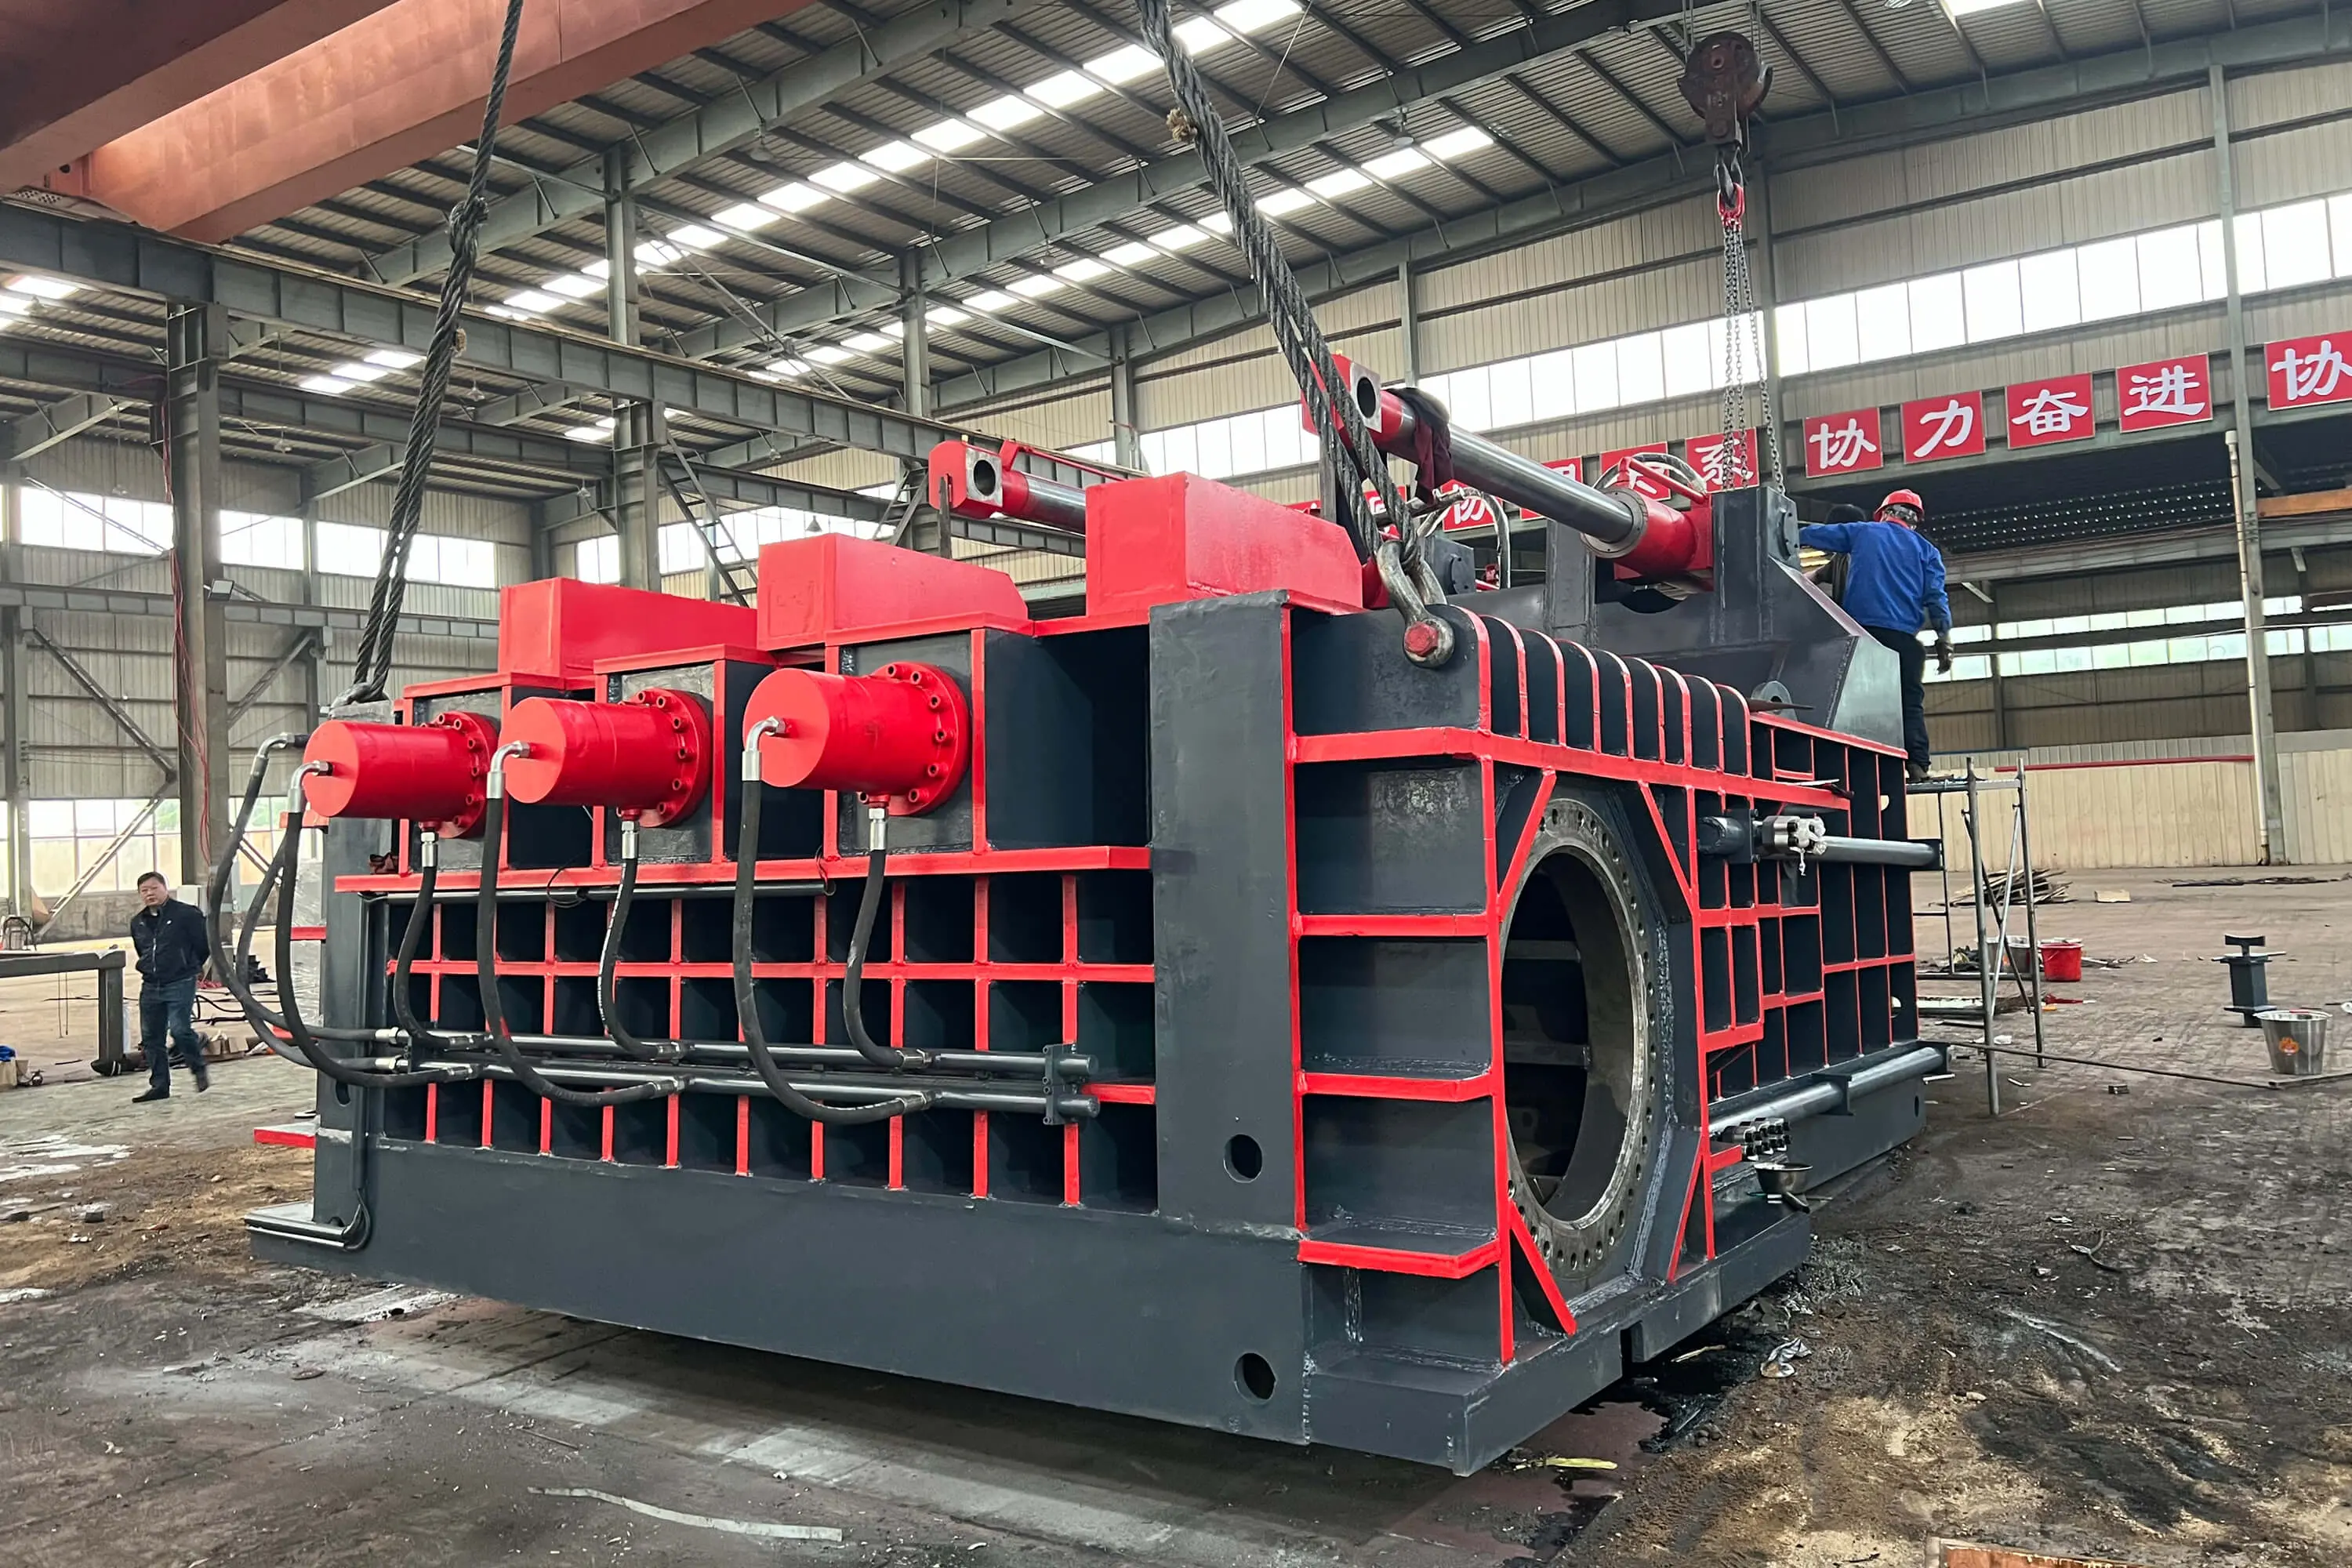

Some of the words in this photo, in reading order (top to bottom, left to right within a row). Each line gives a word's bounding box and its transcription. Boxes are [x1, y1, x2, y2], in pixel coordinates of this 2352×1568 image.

[2270, 339, 2352, 401] 协
[1809, 364, 2206, 470] 协力奋进
